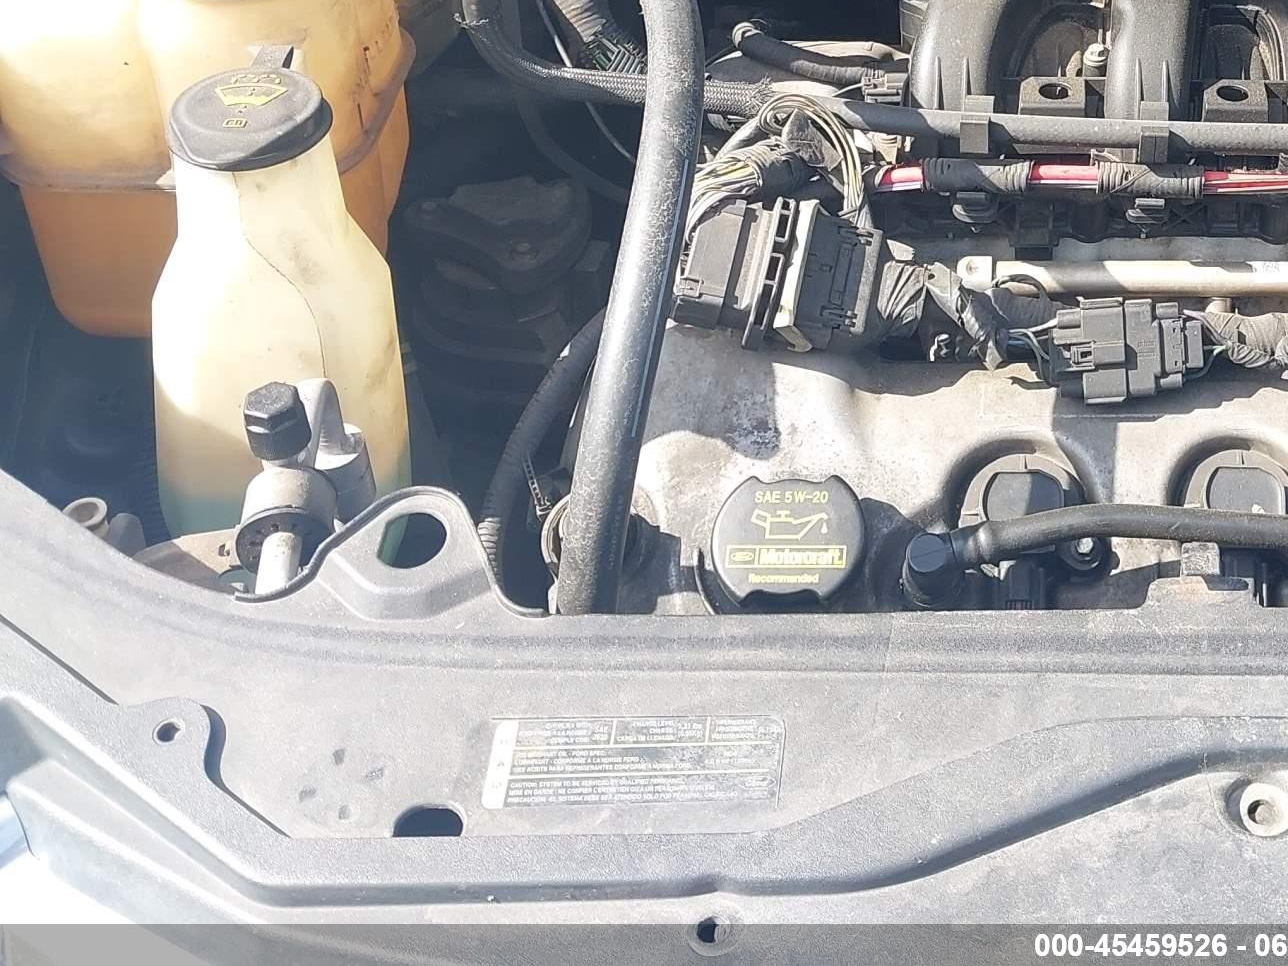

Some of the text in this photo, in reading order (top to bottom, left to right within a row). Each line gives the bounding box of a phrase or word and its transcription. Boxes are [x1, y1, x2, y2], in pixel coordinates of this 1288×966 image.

[755, 491, 828, 503] SAE 5W-20
[759, 549, 842, 565] Motorcraft
[748, 574, 819, 583] Recommended
